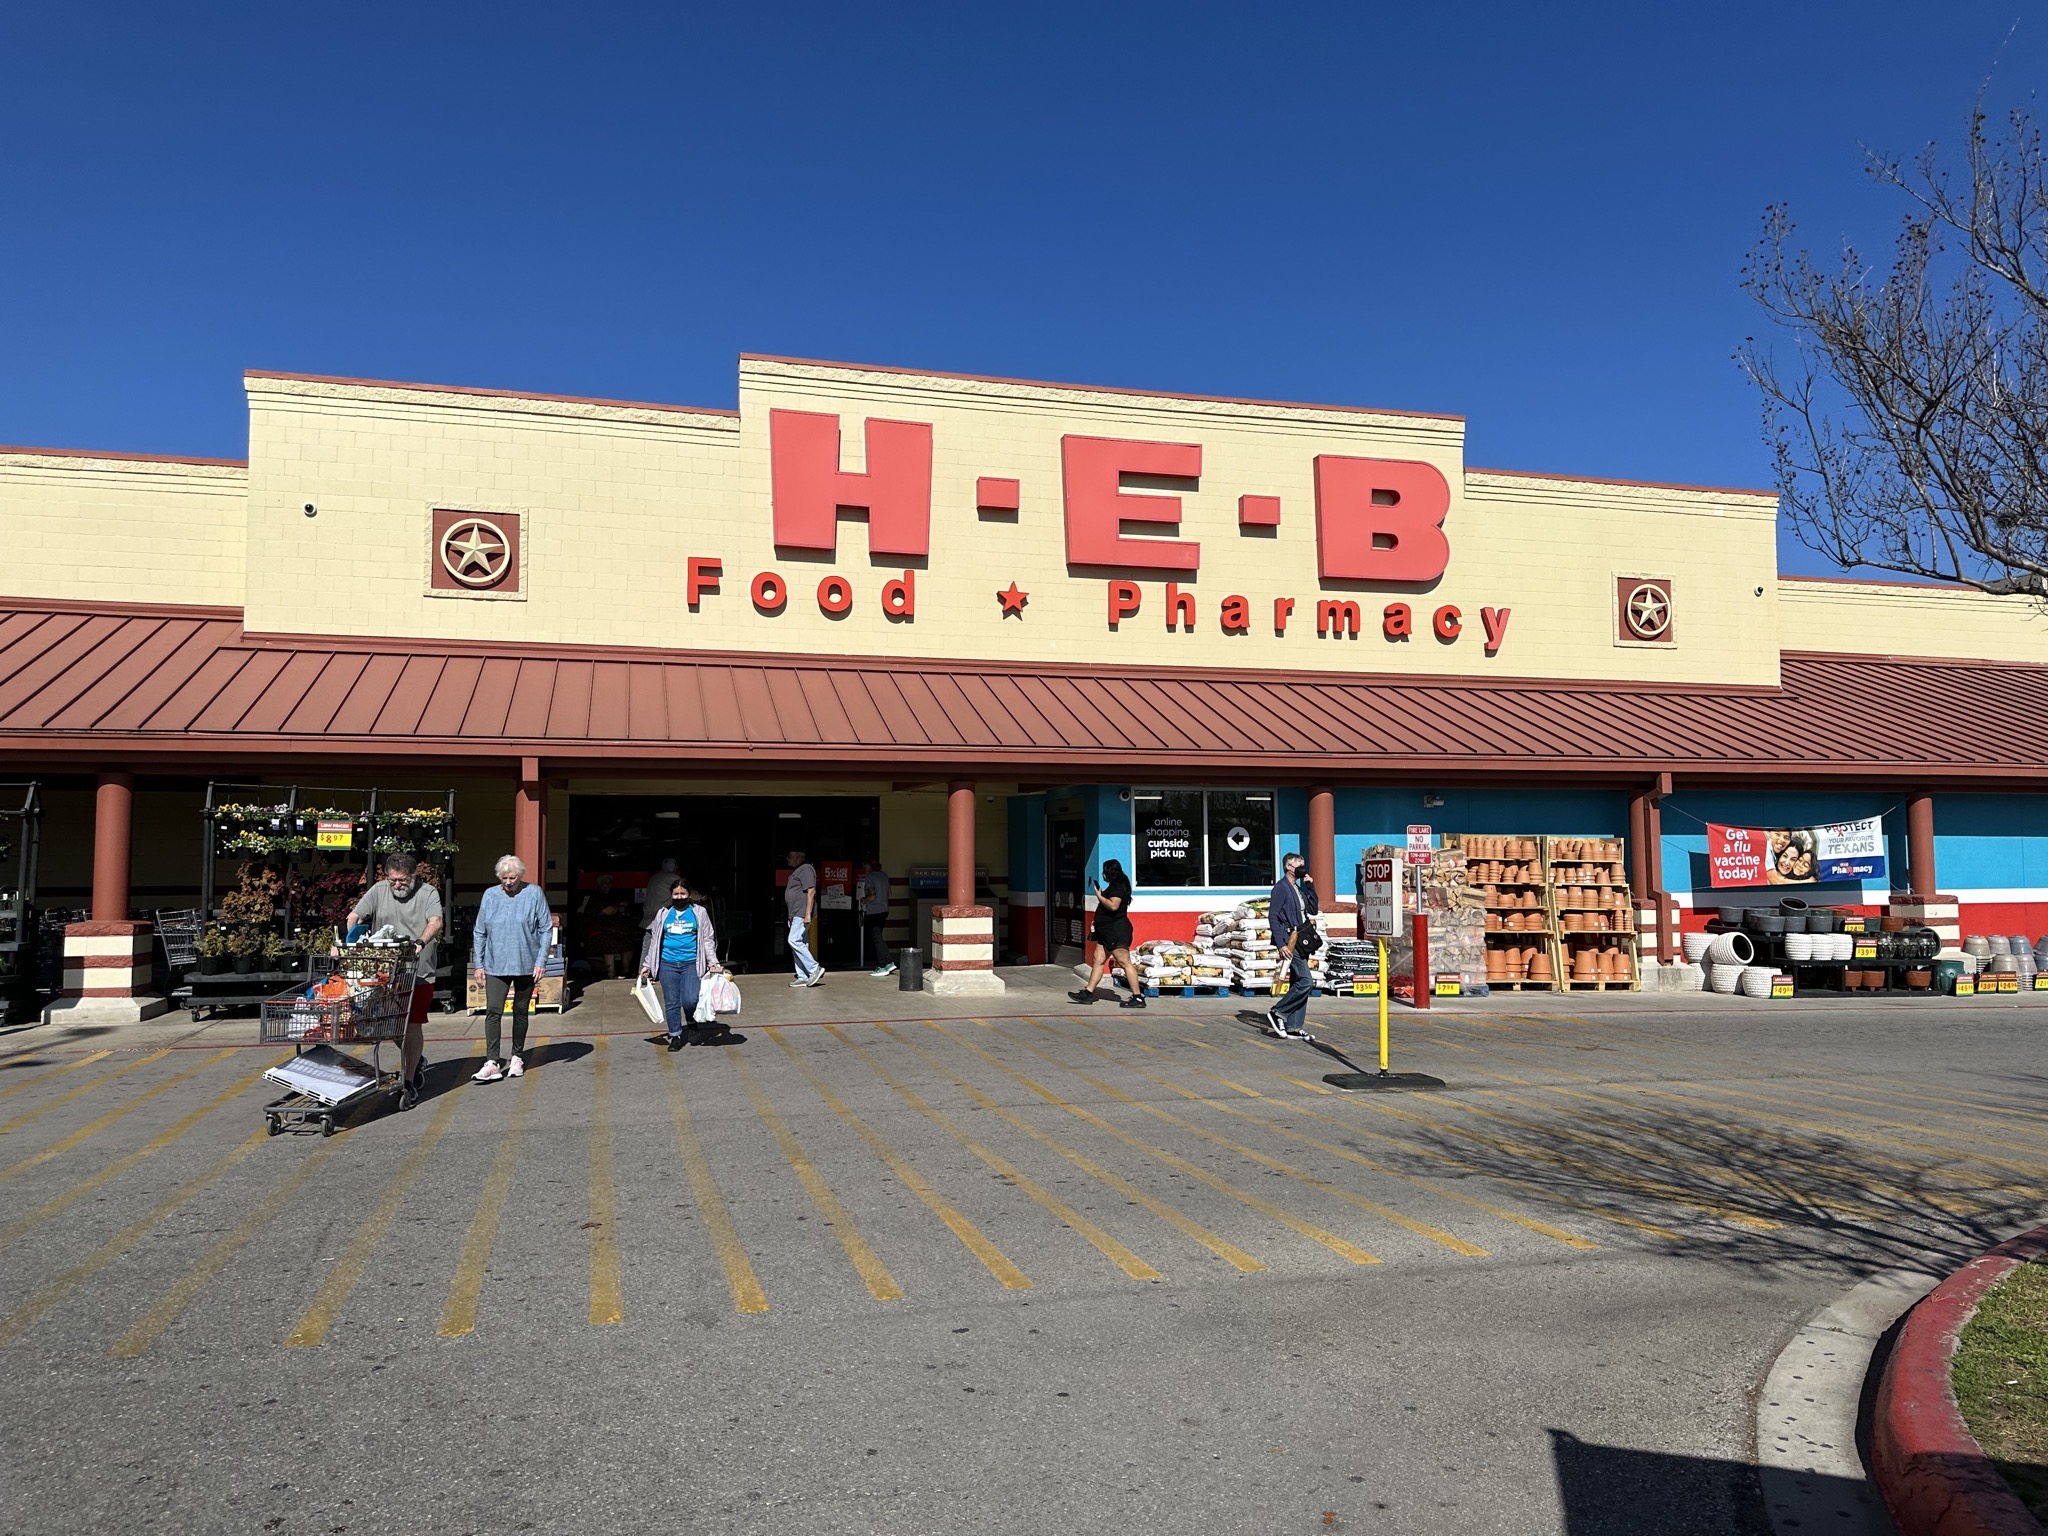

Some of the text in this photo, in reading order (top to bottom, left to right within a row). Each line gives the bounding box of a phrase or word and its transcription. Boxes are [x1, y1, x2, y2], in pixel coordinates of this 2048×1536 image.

[687, 557, 1511, 655] Food Pharmacy
[1154, 817, 1182, 826] online
[1824, 821, 1874, 835] PROTECT
[1726, 829, 1749, 840] Get
[1148, 838, 1189, 848] curbside
[1723, 841, 1751, 853] a flu
[1828, 842, 1875, 854] TEXANS
[1150, 848, 1171, 859] pick
[1714, 853, 1760, 867] vaccine
[1366, 863, 1391, 878] STOP
[1718, 866, 1758, 880] today!
[1831, 865, 1873, 876] Pharmacy
[1374, 884, 1382, 894] FOR
[1366, 896, 1392, 907] PEDESTRIANS
[1375, 908, 1381, 918] IN
[1367, 920, 1391, 931] CROSSWALK
